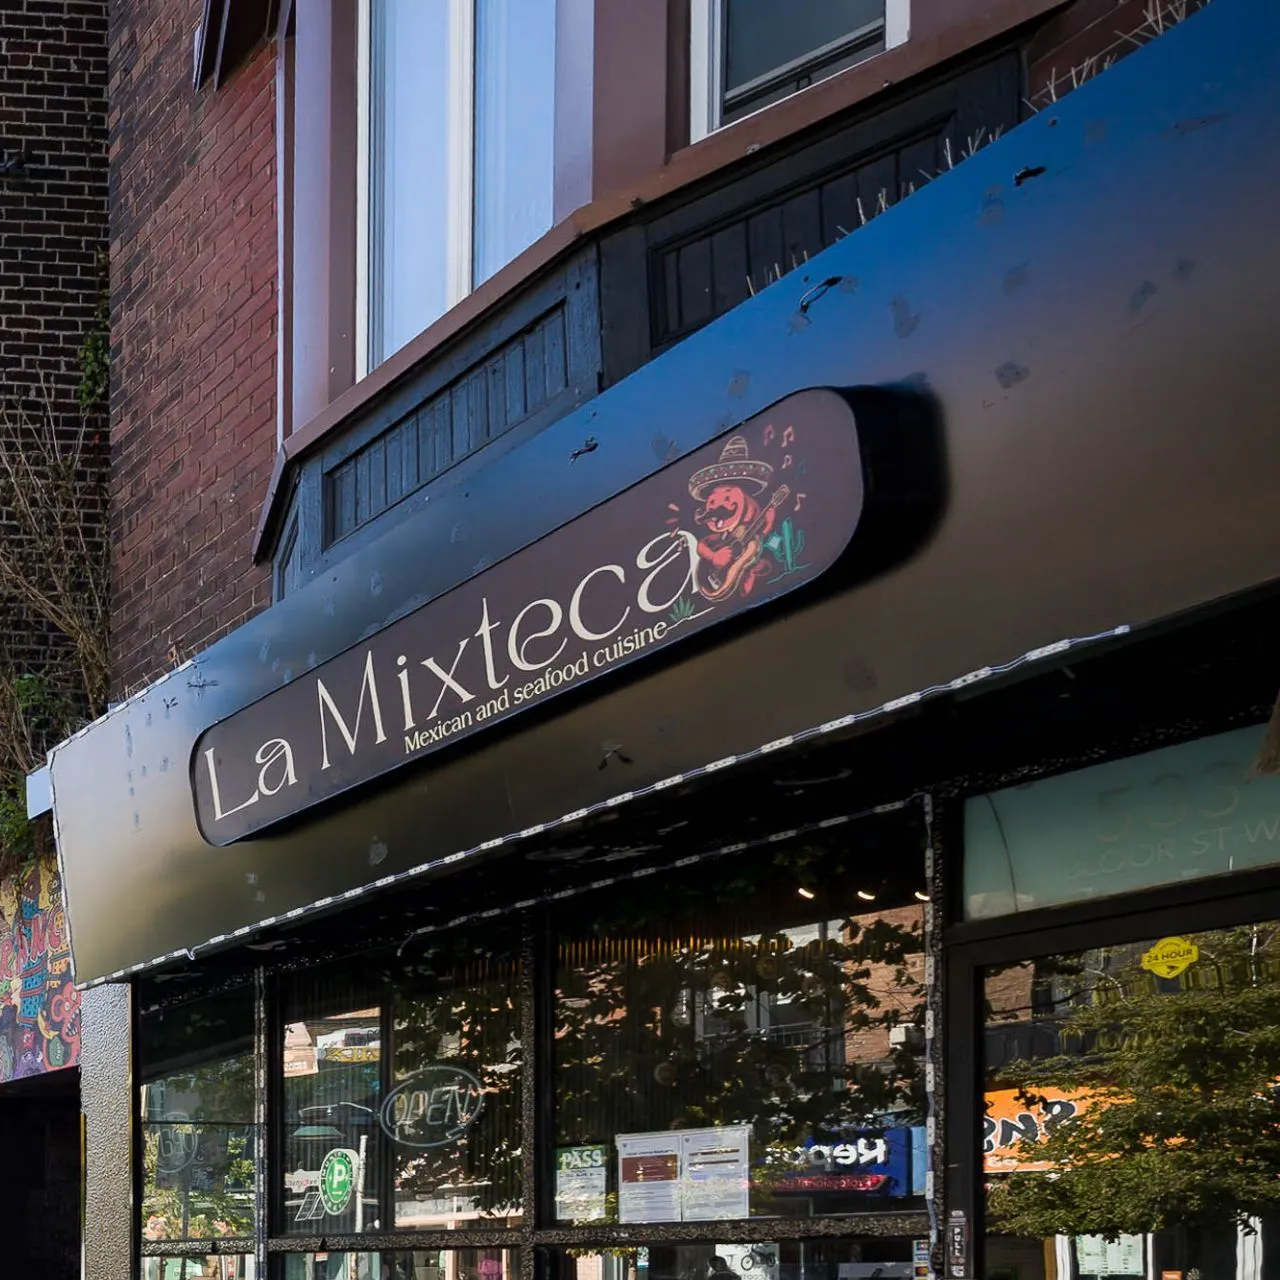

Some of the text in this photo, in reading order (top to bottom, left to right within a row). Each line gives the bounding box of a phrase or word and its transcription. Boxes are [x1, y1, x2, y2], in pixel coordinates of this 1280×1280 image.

[203, 529, 702, 821] La Mixteca
[403, 619, 669, 756] Mexican and seafood cuisine
[1064, 837, 1176, 881] BLOOR
[1189, 824, 1234, 857] ST
[1146, 948, 1193, 963] 24 HOUR
[559, 1149, 602, 1170] PASS
